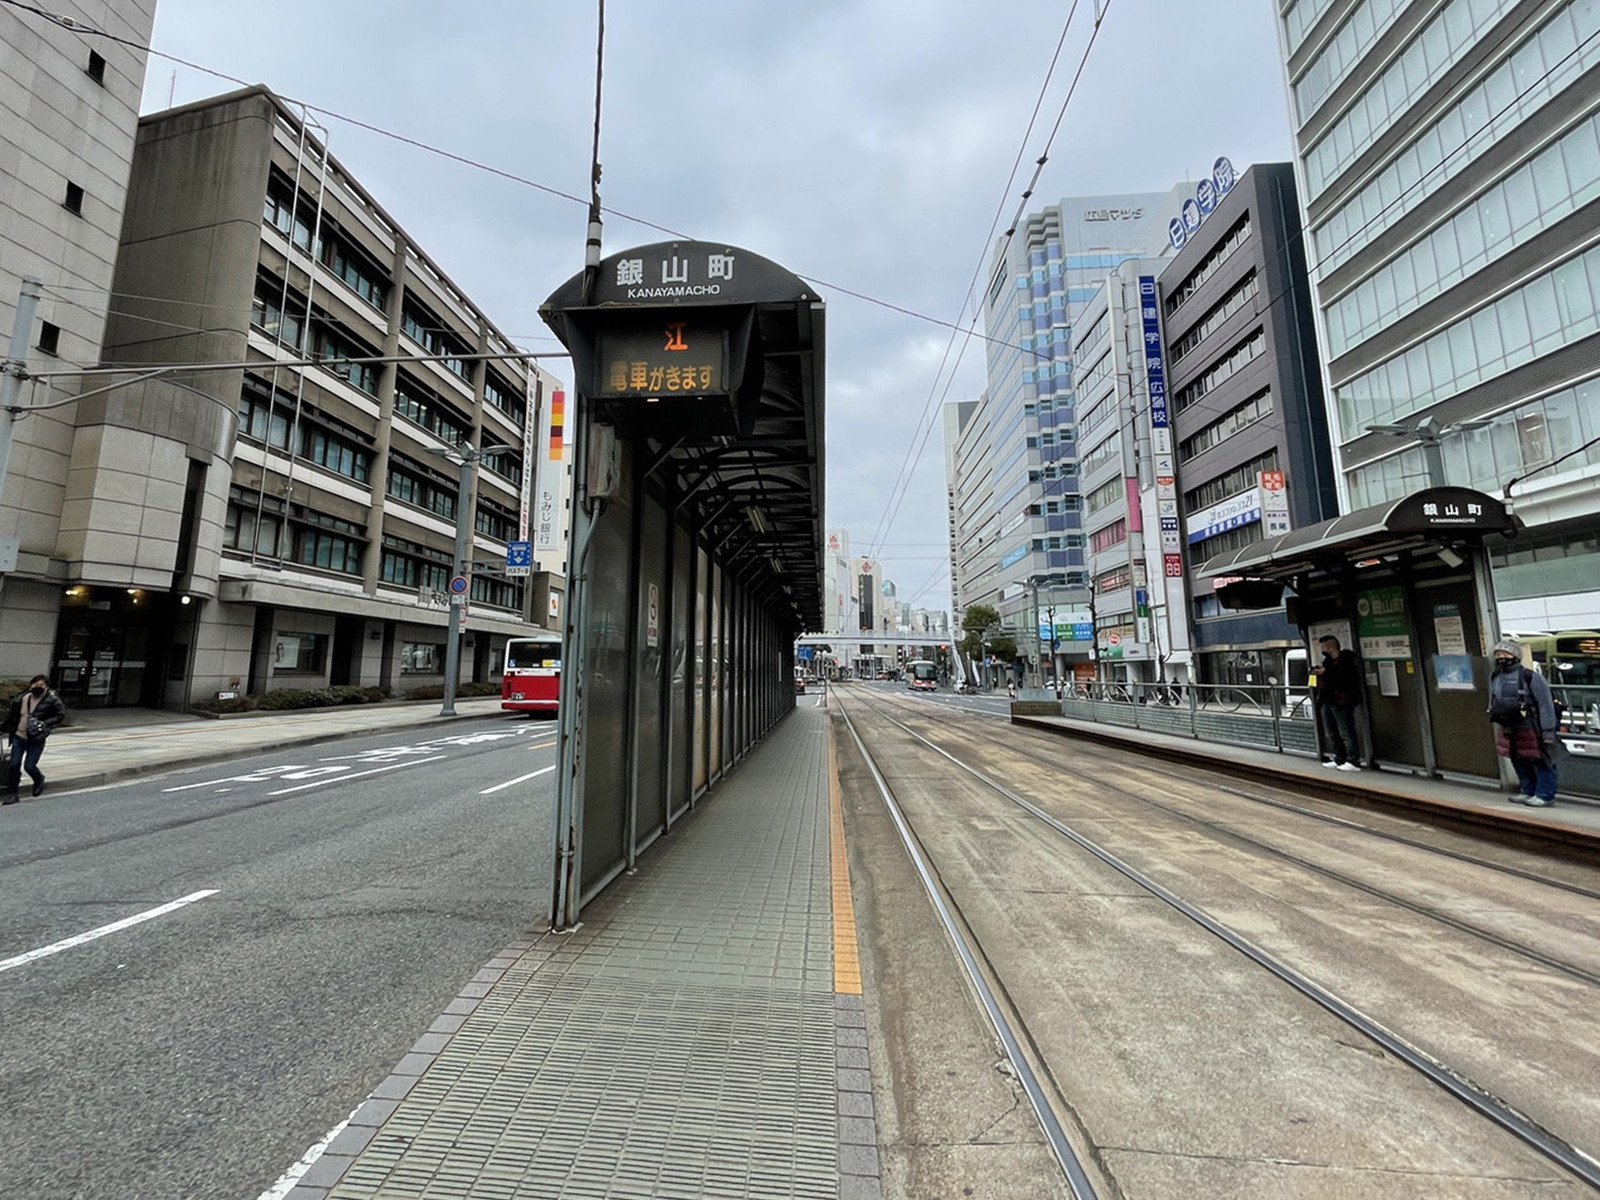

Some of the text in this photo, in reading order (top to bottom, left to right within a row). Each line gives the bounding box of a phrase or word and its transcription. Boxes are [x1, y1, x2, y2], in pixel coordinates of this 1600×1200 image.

[1169, 158, 1232, 248] 日建学院
[616, 255, 735, 286] 銀山町
[627, 285, 720, 298] KANAYAMACHO
[664, 322, 688, 351] 江
[610, 361, 714, 391] 電車がきます
[540, 491, 552, 544] もみじ銀行
[1423, 503, 1481, 515] 銀山町
